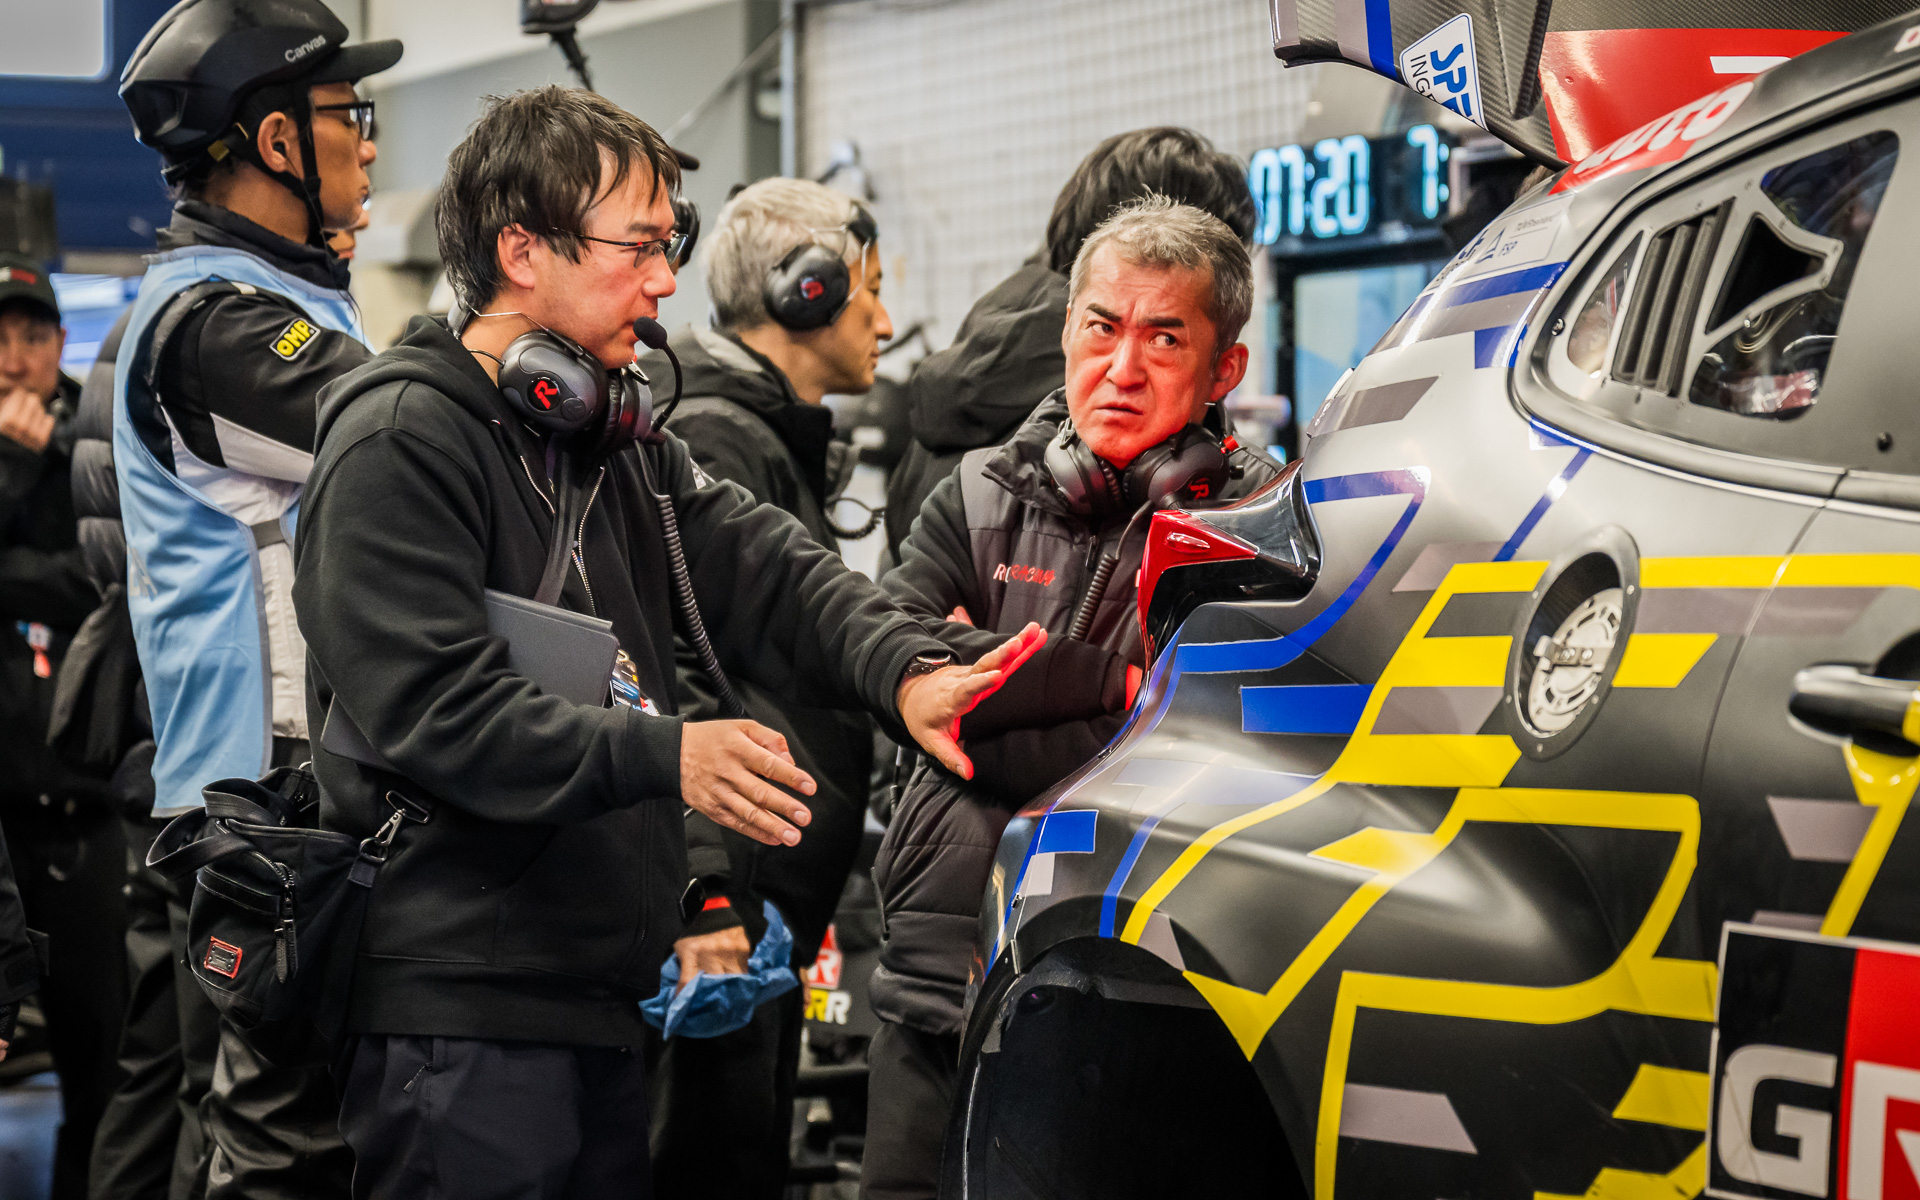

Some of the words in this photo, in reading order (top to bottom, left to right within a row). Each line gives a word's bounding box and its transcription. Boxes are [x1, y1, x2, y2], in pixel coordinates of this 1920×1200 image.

[285, 35, 326, 63] Canvas
[1251, 134, 1370, 245] 07:20
[277, 320, 310, 356] OMP
